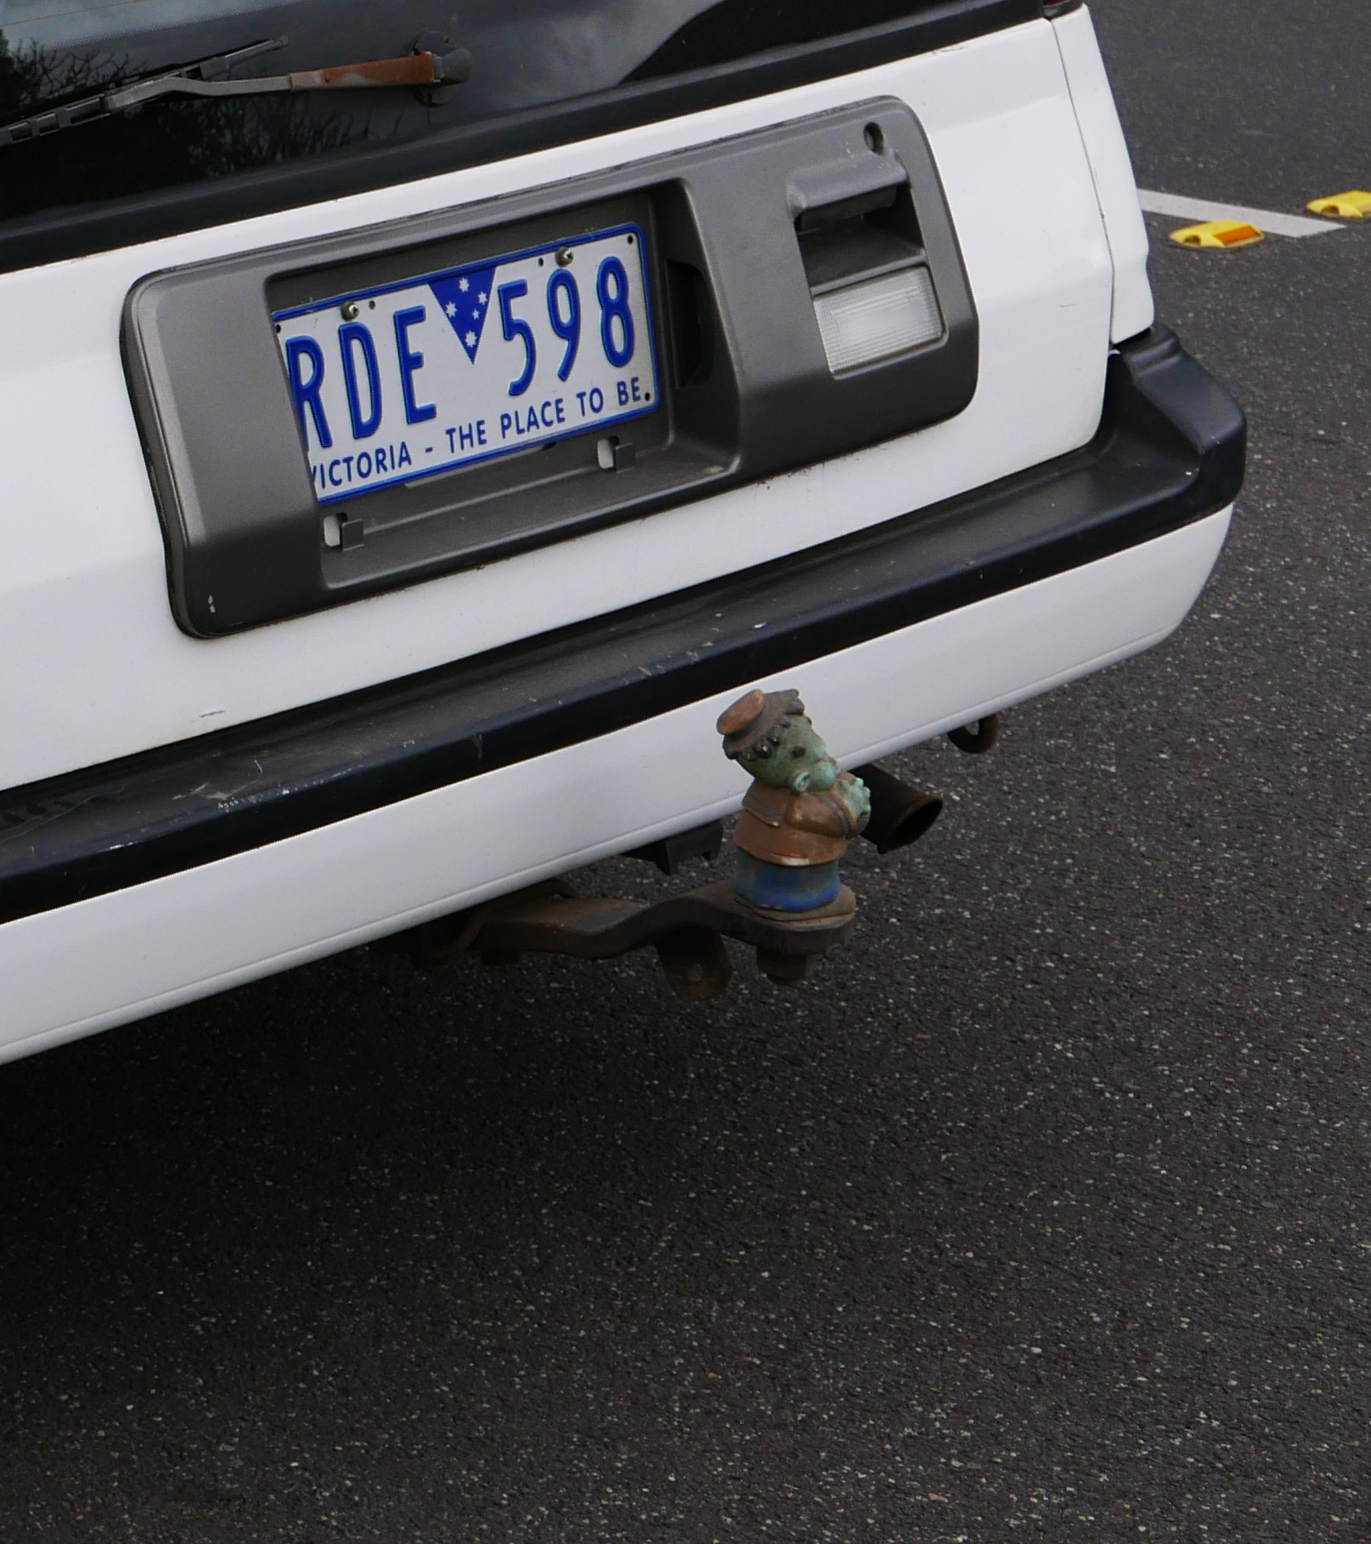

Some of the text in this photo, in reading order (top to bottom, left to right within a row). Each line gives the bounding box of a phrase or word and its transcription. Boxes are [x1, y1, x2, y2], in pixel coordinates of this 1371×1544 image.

[285, 256, 635, 449] RDE 598
[446, 420, 488, 455] THE
[500, 397, 566, 440] PLACE
[576, 389, 605, 418] TO
